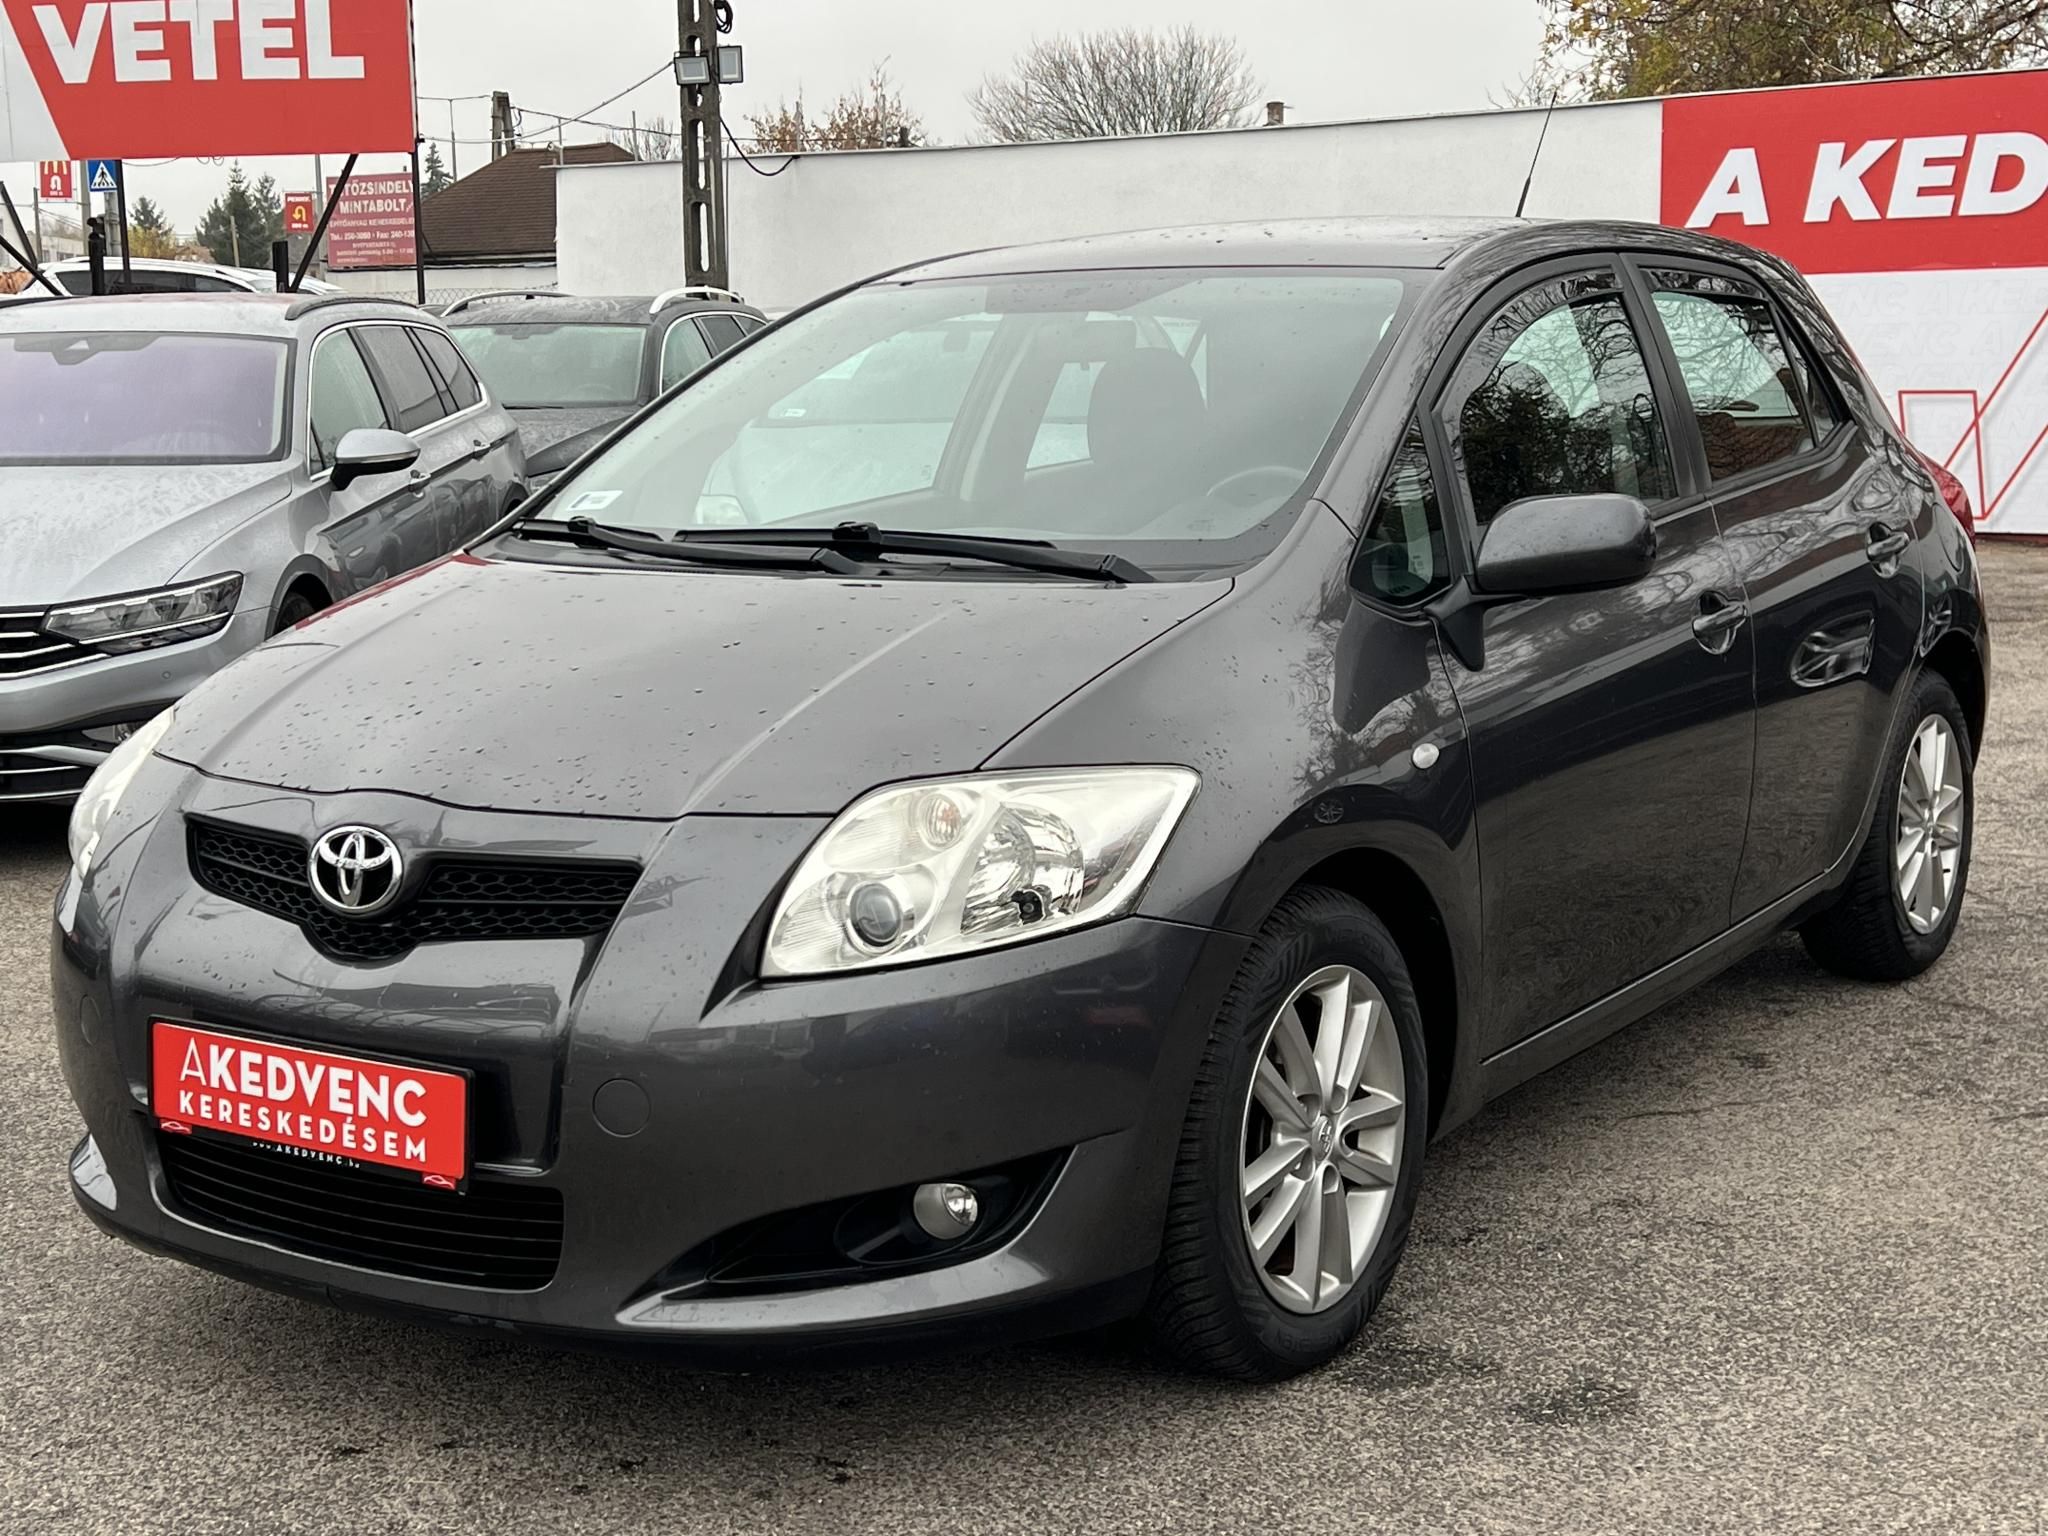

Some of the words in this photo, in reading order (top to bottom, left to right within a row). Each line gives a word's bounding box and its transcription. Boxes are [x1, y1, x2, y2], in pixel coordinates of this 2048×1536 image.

[329, 179, 413, 197] TTŐZSINDELY
[1684, 147, 1770, 228] A
[1803, 131, 2048, 223] KED
[179, 1090, 427, 1163] KERESKEDÉSEM
